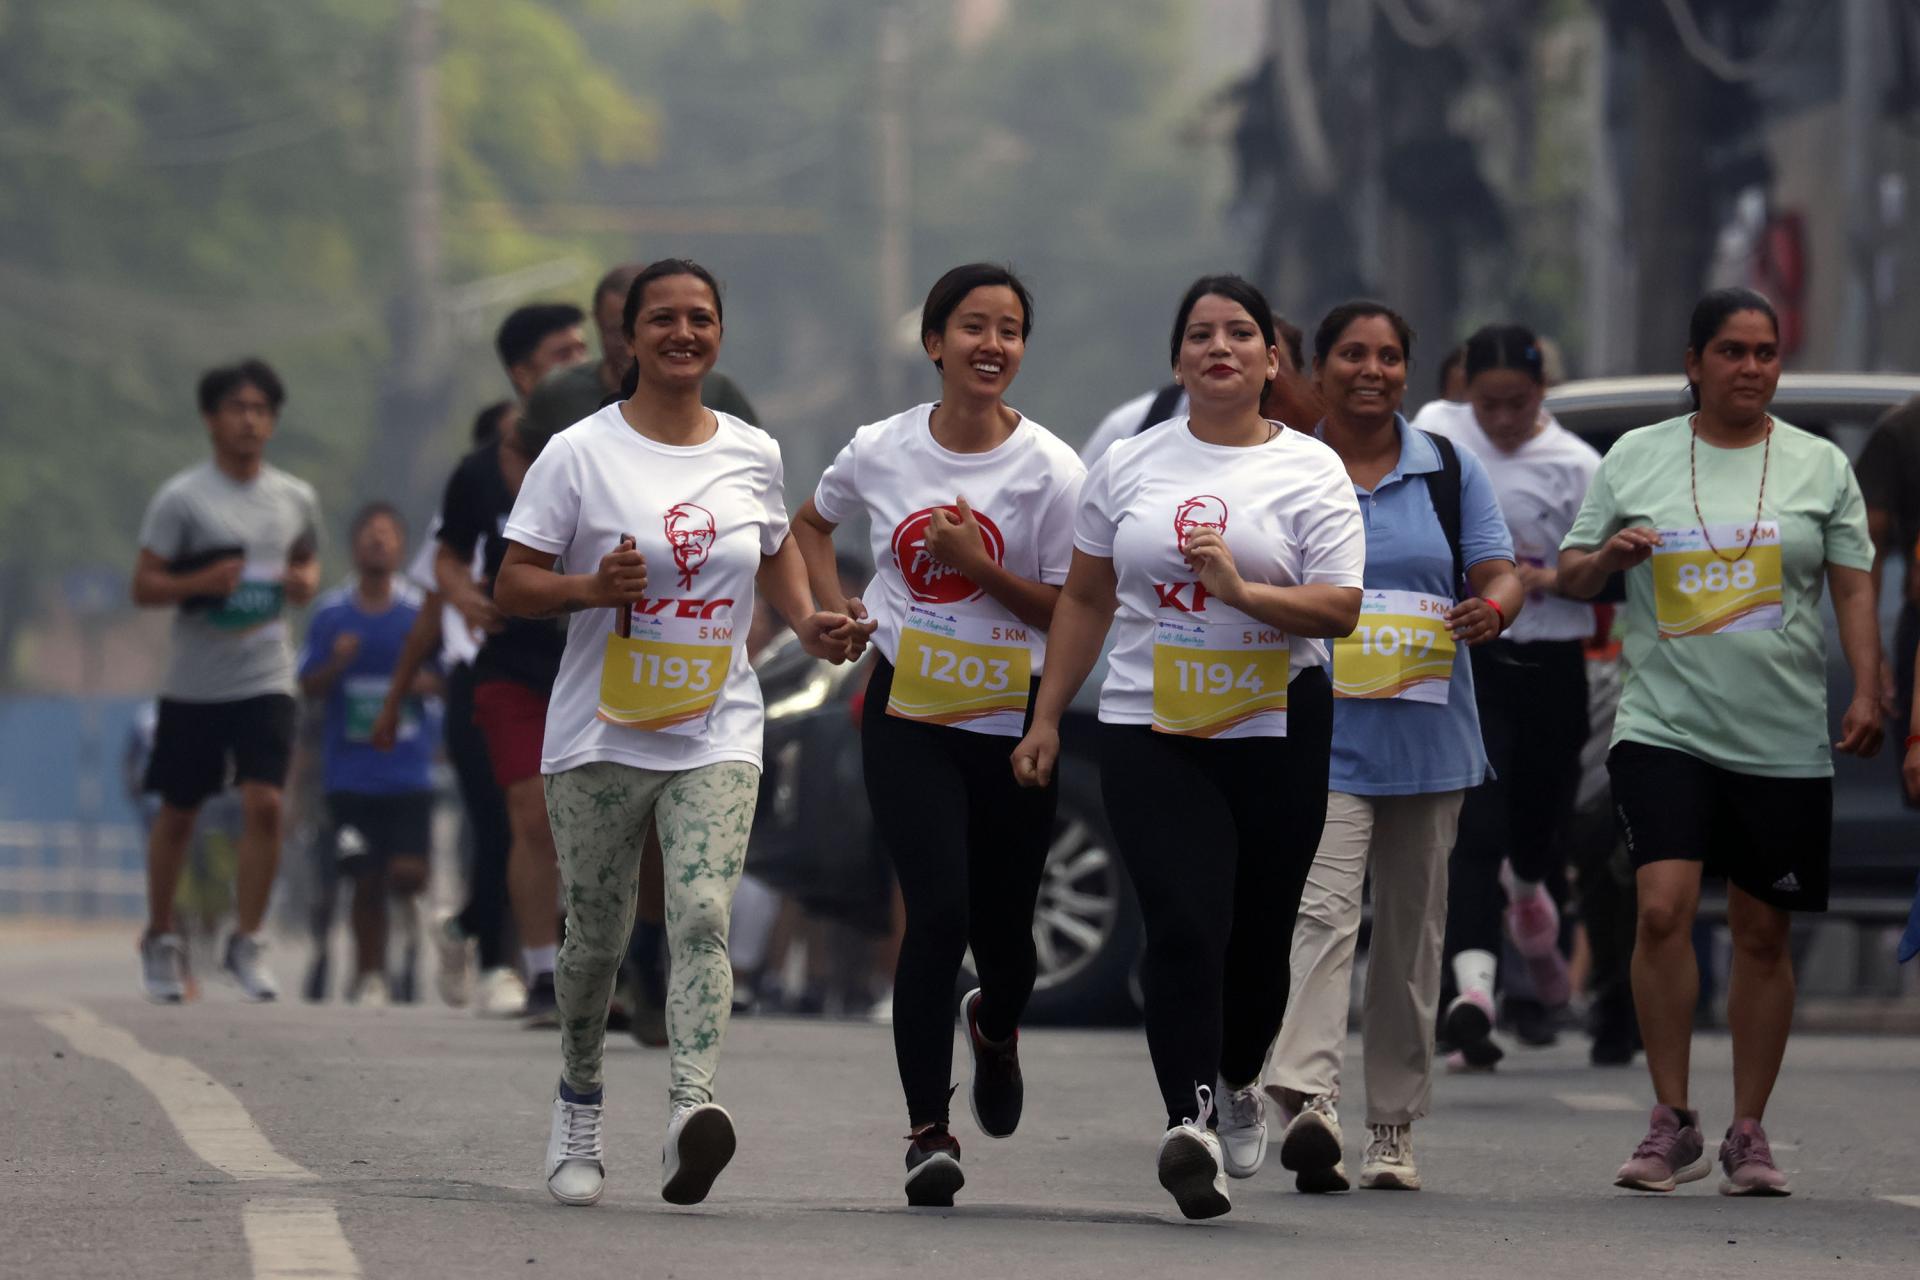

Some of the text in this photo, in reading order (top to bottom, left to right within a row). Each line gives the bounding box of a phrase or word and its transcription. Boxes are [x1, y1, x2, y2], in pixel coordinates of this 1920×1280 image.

[1736, 529, 1745, 541] 5
[1678, 559, 1757, 594] 888
[1420, 600, 1450, 615] 5 KM
[699, 627, 733, 640] 5 KM
[992, 628, 1026, 641] 5 KM
[1243, 631, 1284, 644] 5 KM
[1358, 625, 1435, 659] 1017
[630, 651, 712, 691] 1193
[918, 646, 1010, 690] 1203
[1175, 660, 1263, 694] 1194
